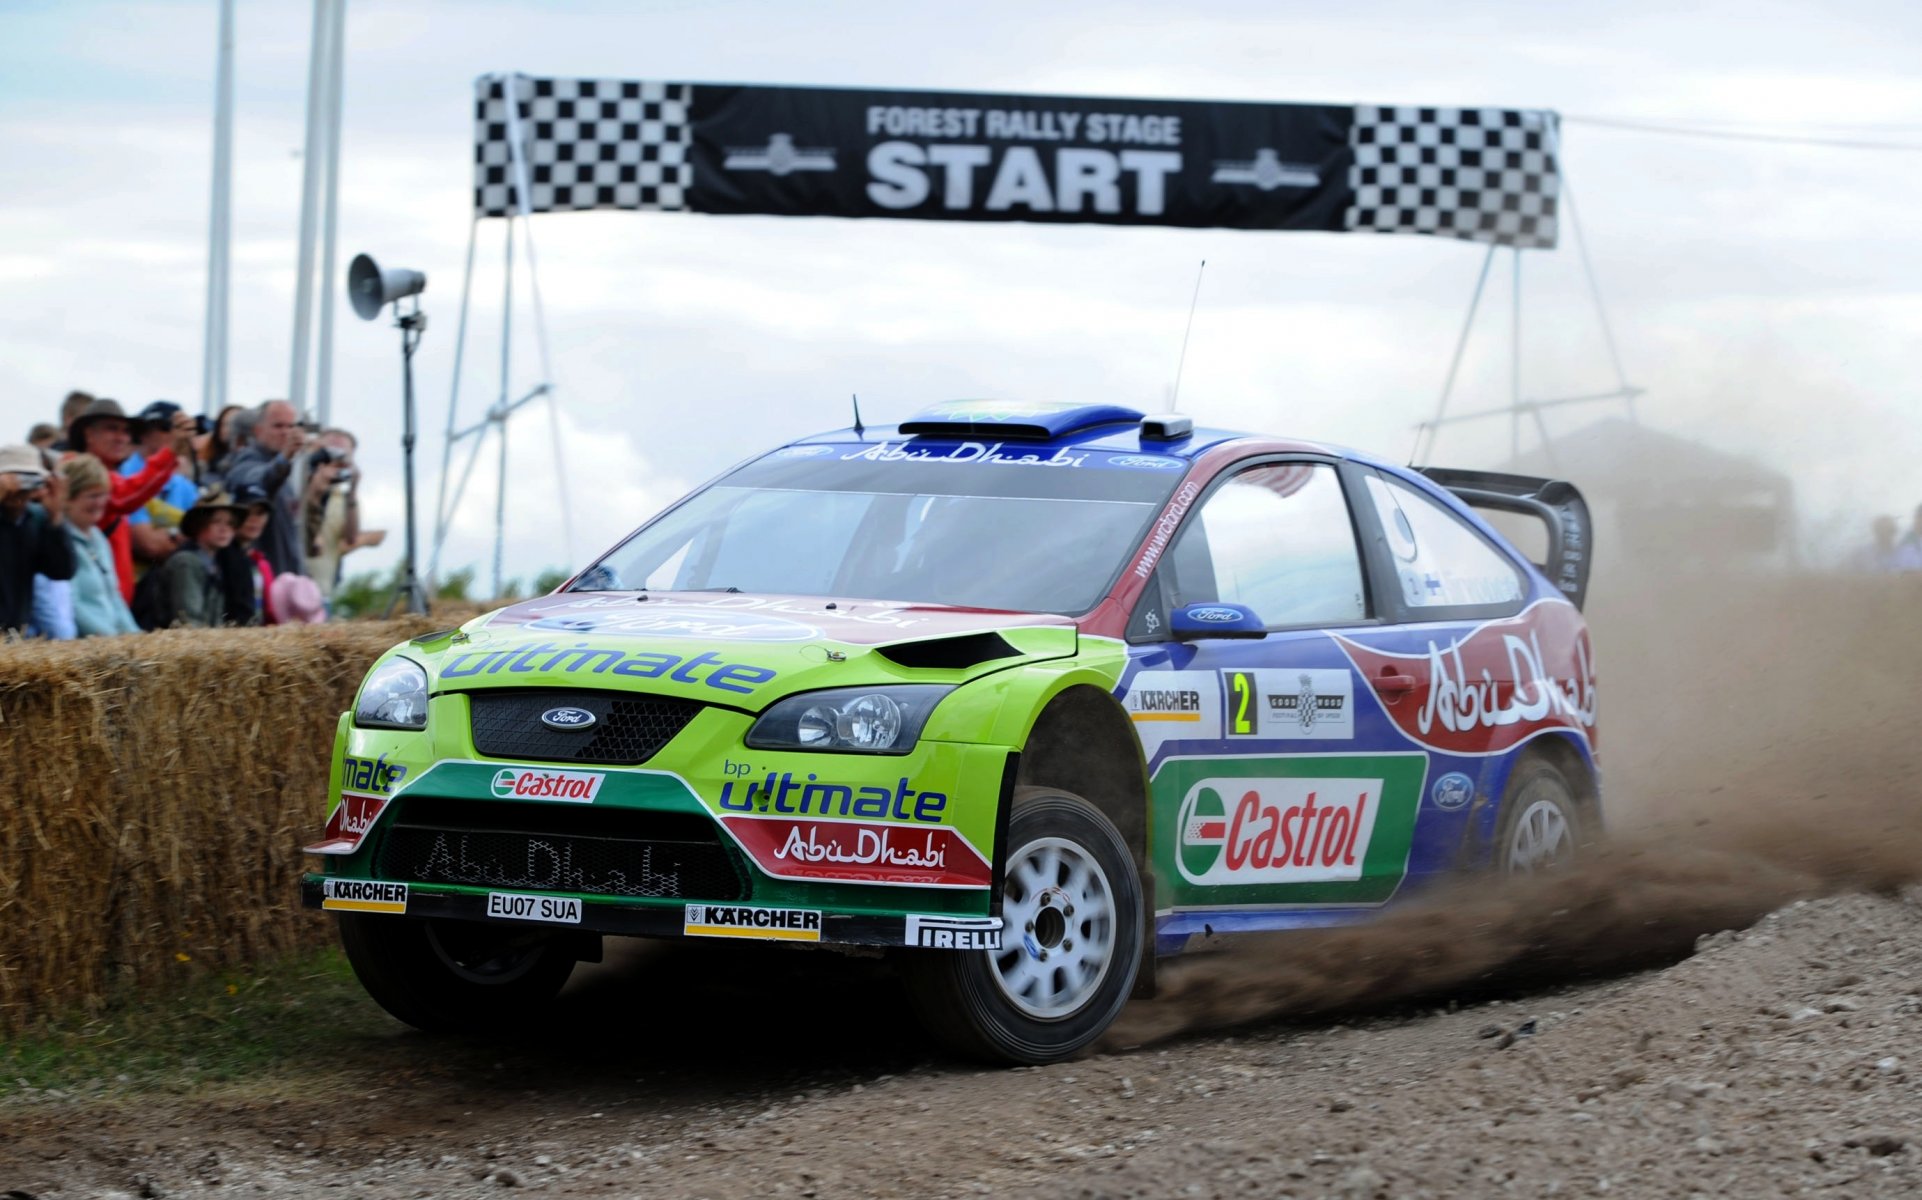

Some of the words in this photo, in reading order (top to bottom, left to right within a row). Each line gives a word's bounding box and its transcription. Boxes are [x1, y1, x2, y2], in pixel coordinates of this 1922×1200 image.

[867, 106, 981, 137] FOREST
[985, 109, 1082, 141] RALLY
[1086, 113, 1182, 145] STAGE
[866, 140, 1183, 215] START
[949, 441, 1090, 468] Dhabi
[1196, 607, 1233, 622] Ford
[439, 642, 777, 694] ultimate
[1140, 690, 1200, 711] KÄRCHER
[1233, 672, 1251, 734] 2
[551, 710, 582, 724] Ford
[724, 759, 751, 778] bp
[514, 771, 597, 800] Castrol
[719, 772, 947, 823] ultimate
[1438, 778, 1468, 804] Ford
[1225, 790, 1368, 872] Castrol
[774, 825, 858, 862] Abu
[858, 827, 947, 868] Dhabi
[334, 881, 407, 902] KÄRCHER
[491, 895, 536, 917] EU07
[540, 899, 578, 920] SUA
[704, 906, 820, 930] KÄRCHER
[905, 914, 1004, 950] PIRELLI
